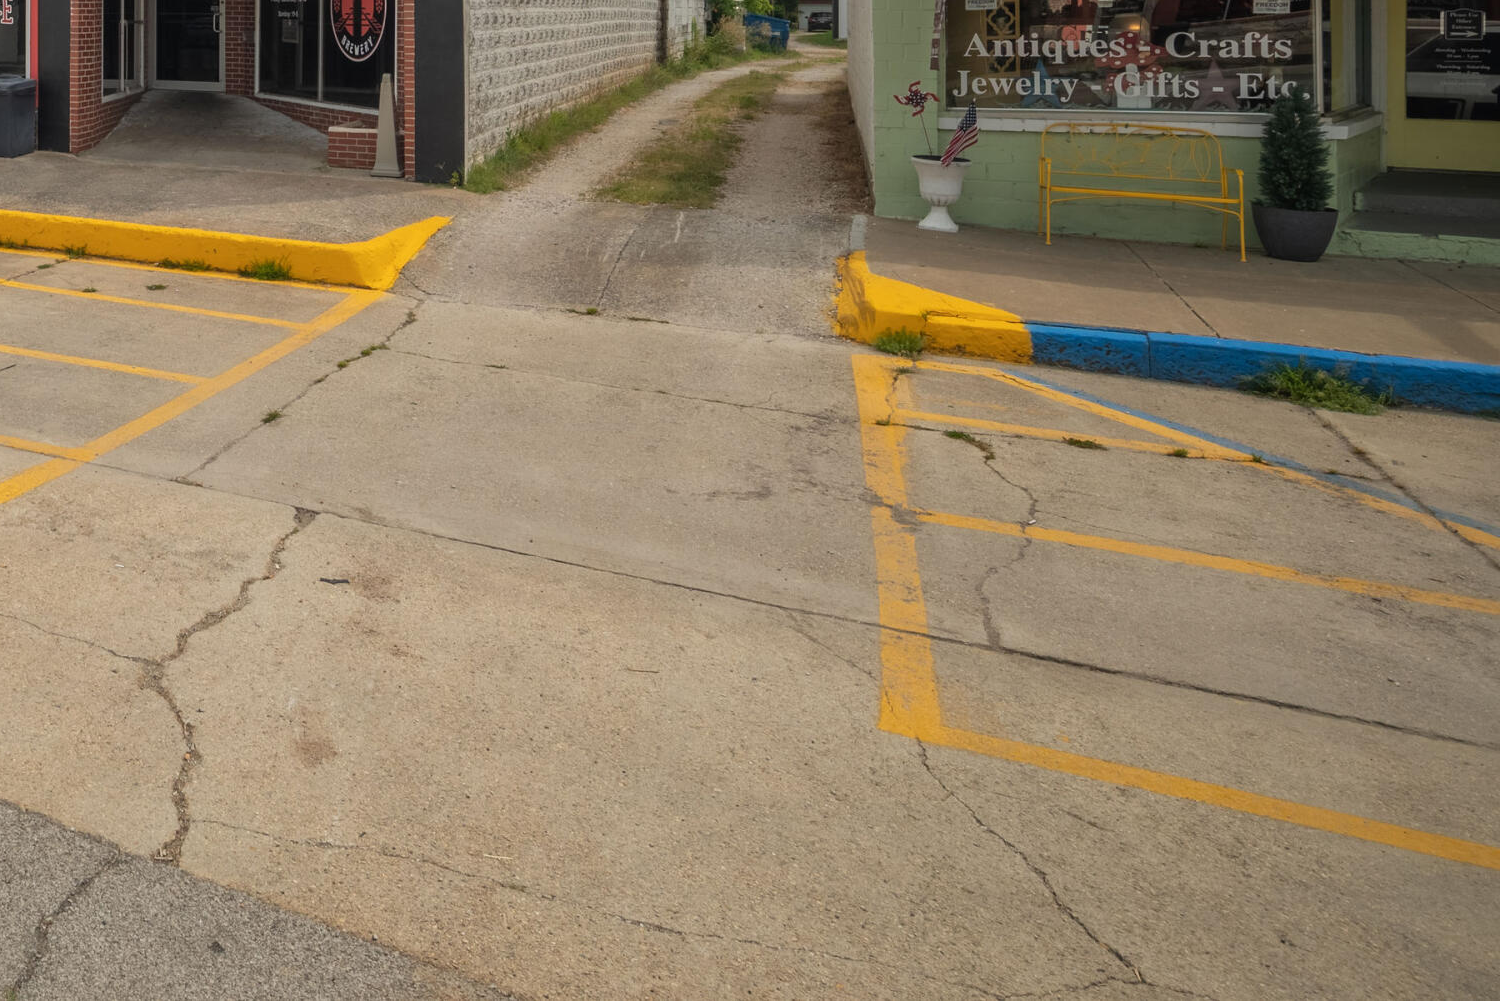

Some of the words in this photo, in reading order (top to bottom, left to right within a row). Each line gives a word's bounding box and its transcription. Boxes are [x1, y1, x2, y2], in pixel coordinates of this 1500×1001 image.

[341, 35, 374, 56] BREWERY
[963, 32, 1127, 64] Antiques
[1165, 31, 1293, 59] Crafts
[953, 70, 1079, 102] Jewelry
[1114, 71, 1200, 98] Gifts
